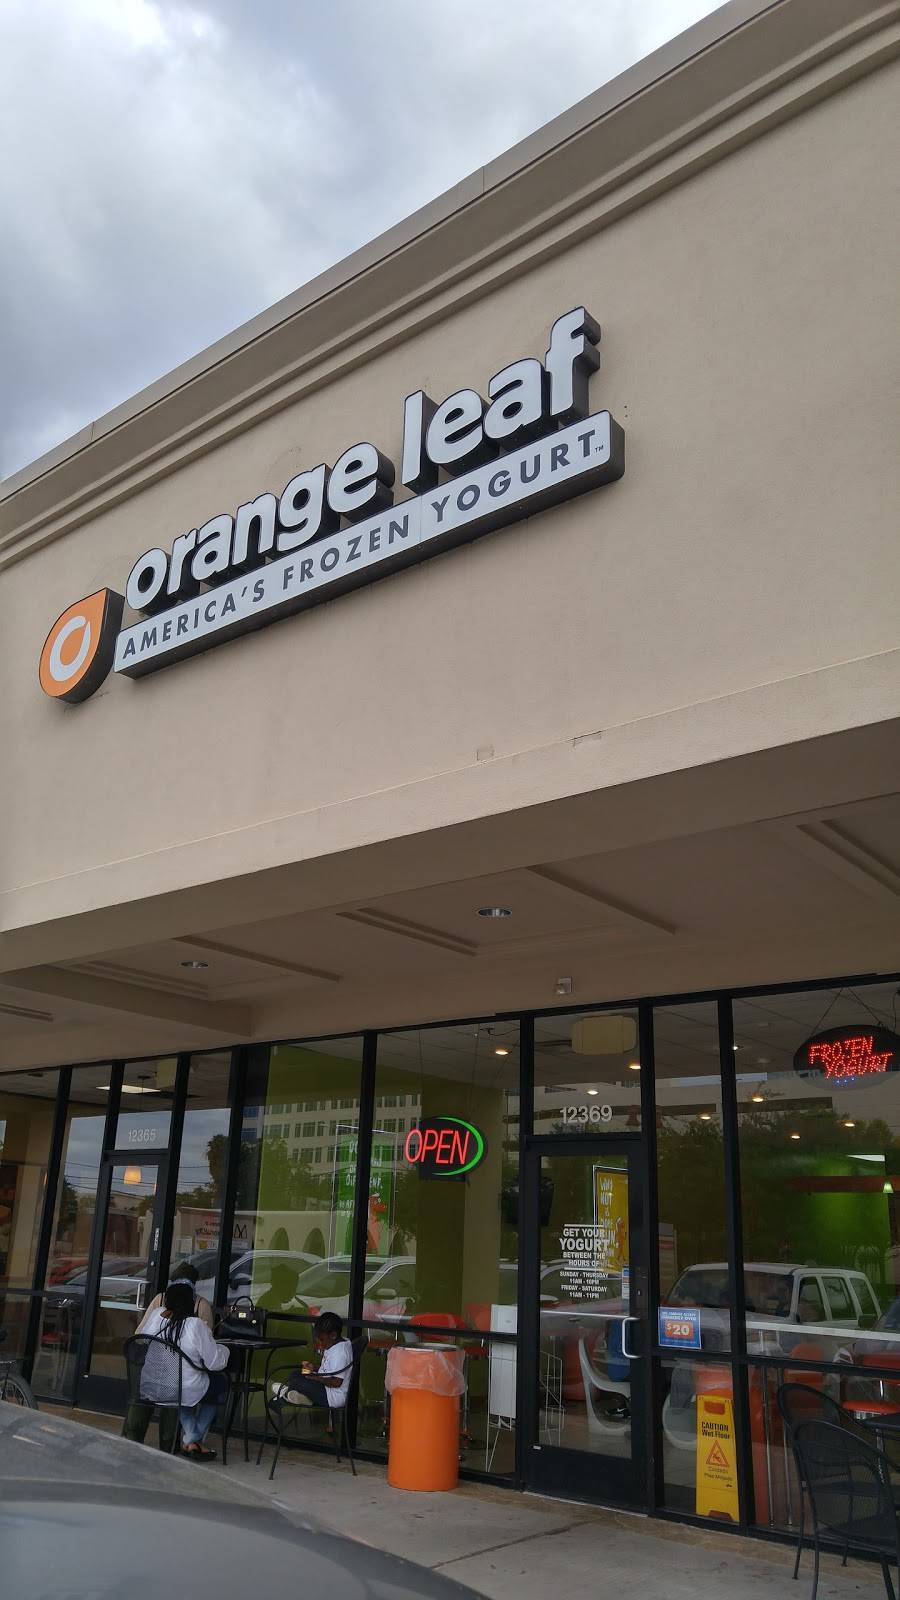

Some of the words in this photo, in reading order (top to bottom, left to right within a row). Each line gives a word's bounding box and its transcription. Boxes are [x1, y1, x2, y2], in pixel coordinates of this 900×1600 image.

[126, 442, 381, 610] orange
[401, 306, 587, 486] leaf
[122, 579, 265, 660] AMERICA'S
[282, 515, 409, 589] FROZEN
[430, 429, 596, 522] YOGURT
[809, 1035, 873, 1064] FROZEN
[824, 1051, 894, 1079] YOGURT
[559, 1104, 613, 1124] 12369
[128, 1128, 156, 1142] 12365
[405, 1129, 470, 1164] OPEN
[563, 1229, 579, 1237] GET
[581, 1229, 605, 1238] YOUR
[559, 1238, 609, 1251] YOGURT
[563, 1251, 592, 1259] BETWEEN
[593, 1251, 606, 1260] THE
[581, 1285, 608, 1293] SATURDAY
[701, 1421, 729, 1431] CAUTION
